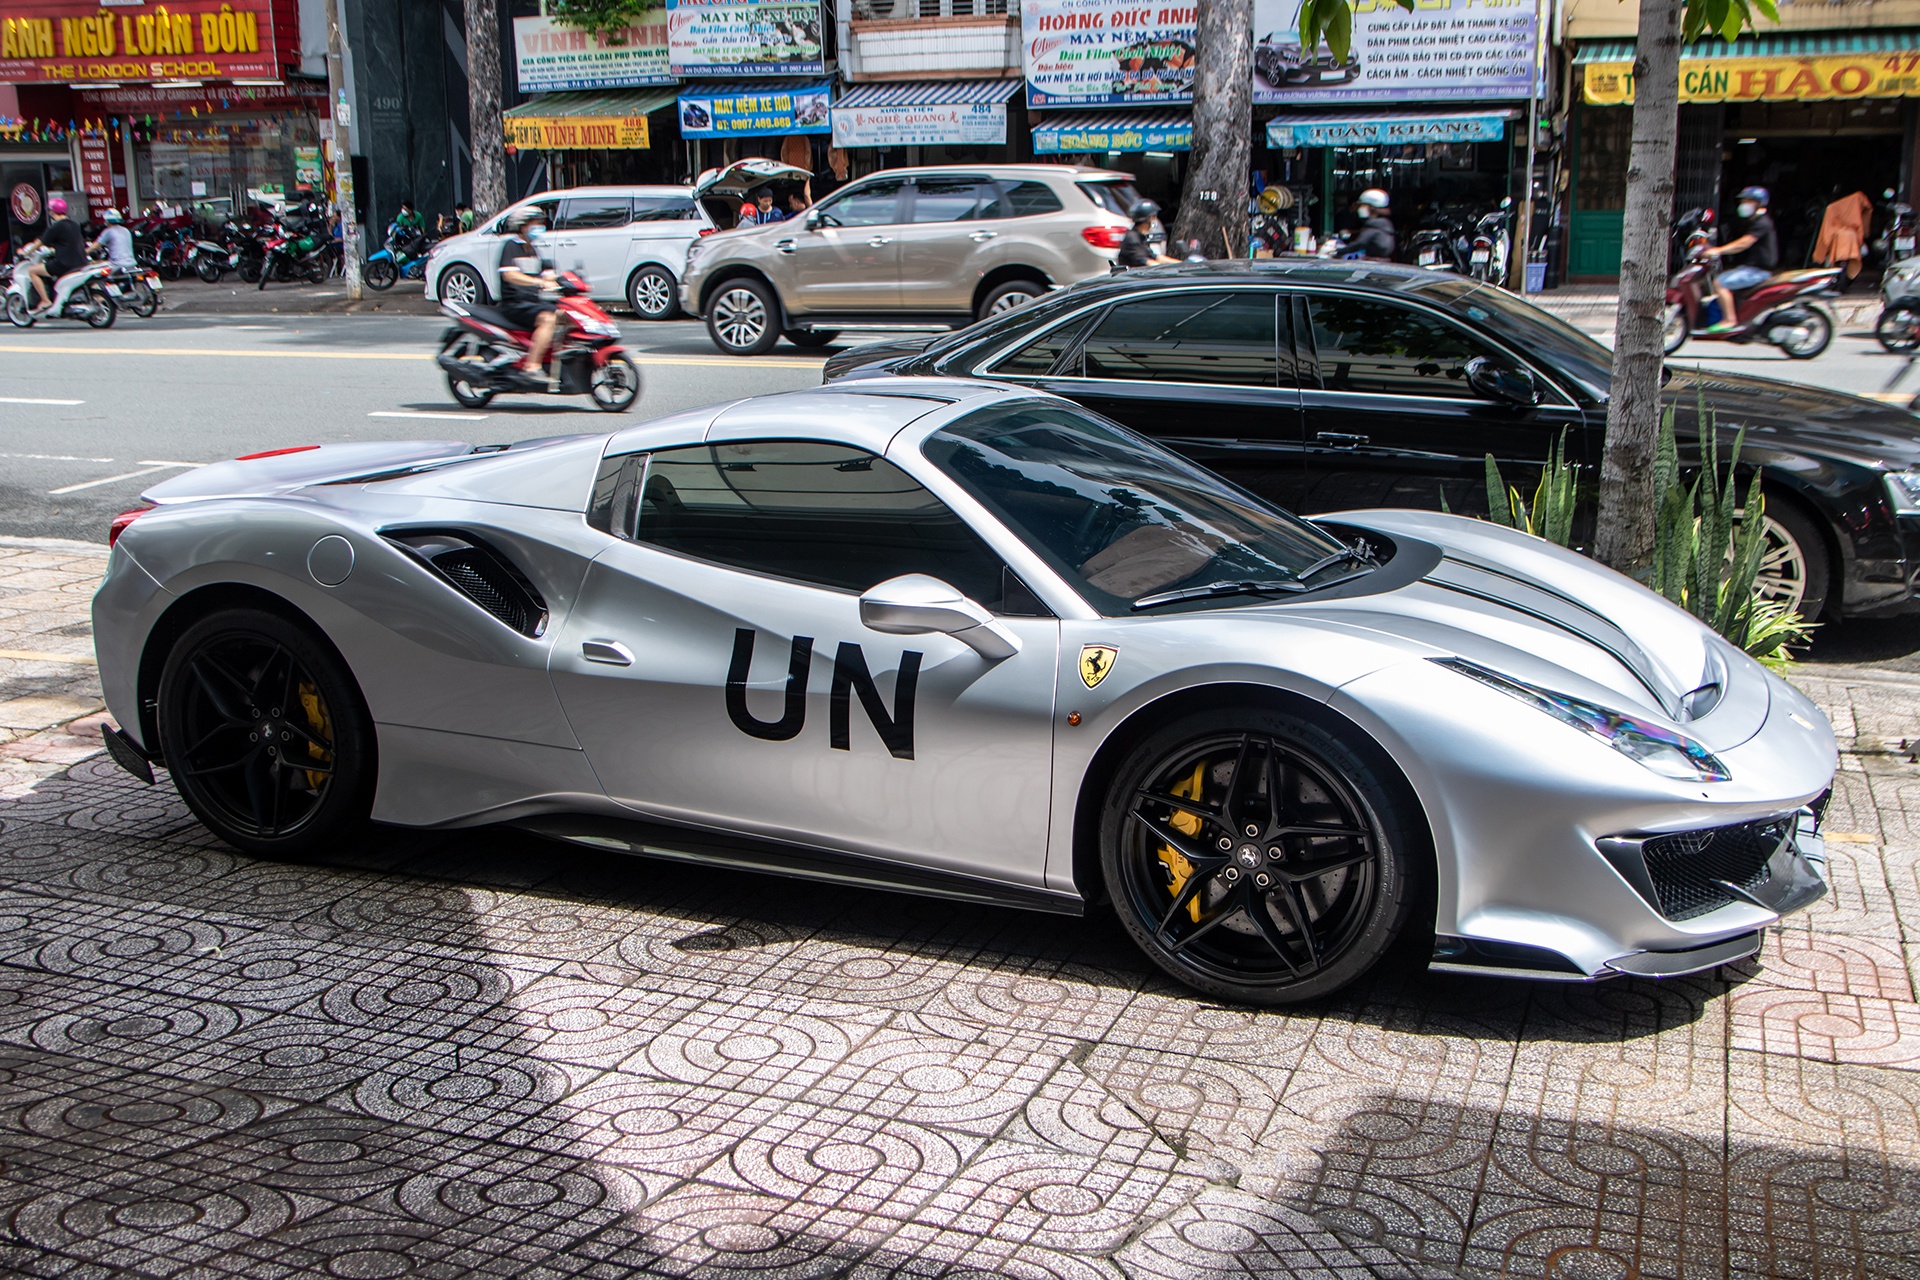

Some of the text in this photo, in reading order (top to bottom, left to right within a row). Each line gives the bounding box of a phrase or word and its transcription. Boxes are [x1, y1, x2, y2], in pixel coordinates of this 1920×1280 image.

[700, 12, 730, 23] MAY
[768, 10, 786, 22] XE
[1039, 7, 1198, 31] HOÀNG ĐỨC ANH
[1368, 23, 1390, 33] CUNG
[1392, 20, 1409, 31] CẤP
[1450, 19, 1464, 30] ÂM
[1468, 19, 1496, 29] THANH
[1499, 19, 1509, 28] XE
[1513, 17, 1528, 27] HƠI
[2, 3, 259, 58] ANH NGỮ LUÂN ĐÔN
[708, 25, 727, 34] Film
[1070, 33, 1105, 45] MAY
[1153, 30, 1173, 41] XE
[522, 23, 669, 54] VĨNH MNH
[1367, 31, 1527, 48] DÁN PHIM CÁCH NHIỆT CAO CẤP USA
[1059, 49, 1083, 61] Dán
[1086, 48, 1112, 61] Film
[1485, 47, 1503, 59] CÁC
[41, 65, 75, 79] THE
[79, 63, 148, 79] LONDON
[150, 61, 222, 77] SCHOOL
[1034, 74, 1052, 84] MAY
[1075, 73, 1085, 82] XE
[1087, 70, 1102, 82] HƠI
[1366, 67, 1391, 80] CÁCH
[1393, 66, 1408, 79] ÂM
[1417, 66, 1442, 78] CÁCH
[1445, 65, 1472, 79] NHIỆT
[1476, 62, 1509, 77] CHỐNG
[1685, 64, 1729, 94] CÁN
[373, 96, 401, 110] 490
[714, 94, 791, 117] MAY NỆM XE HƠI
[971, 104, 991, 114] 484
[905, 113, 945, 125] QUANG
[1387, 119, 1482, 136] KHANG
[580, 124, 618, 146] MINH
[1060, 131, 1109, 150] HOÀNG
[1111, 129, 1143, 149] ĐỨC
[725, 627, 924, 761] UN
